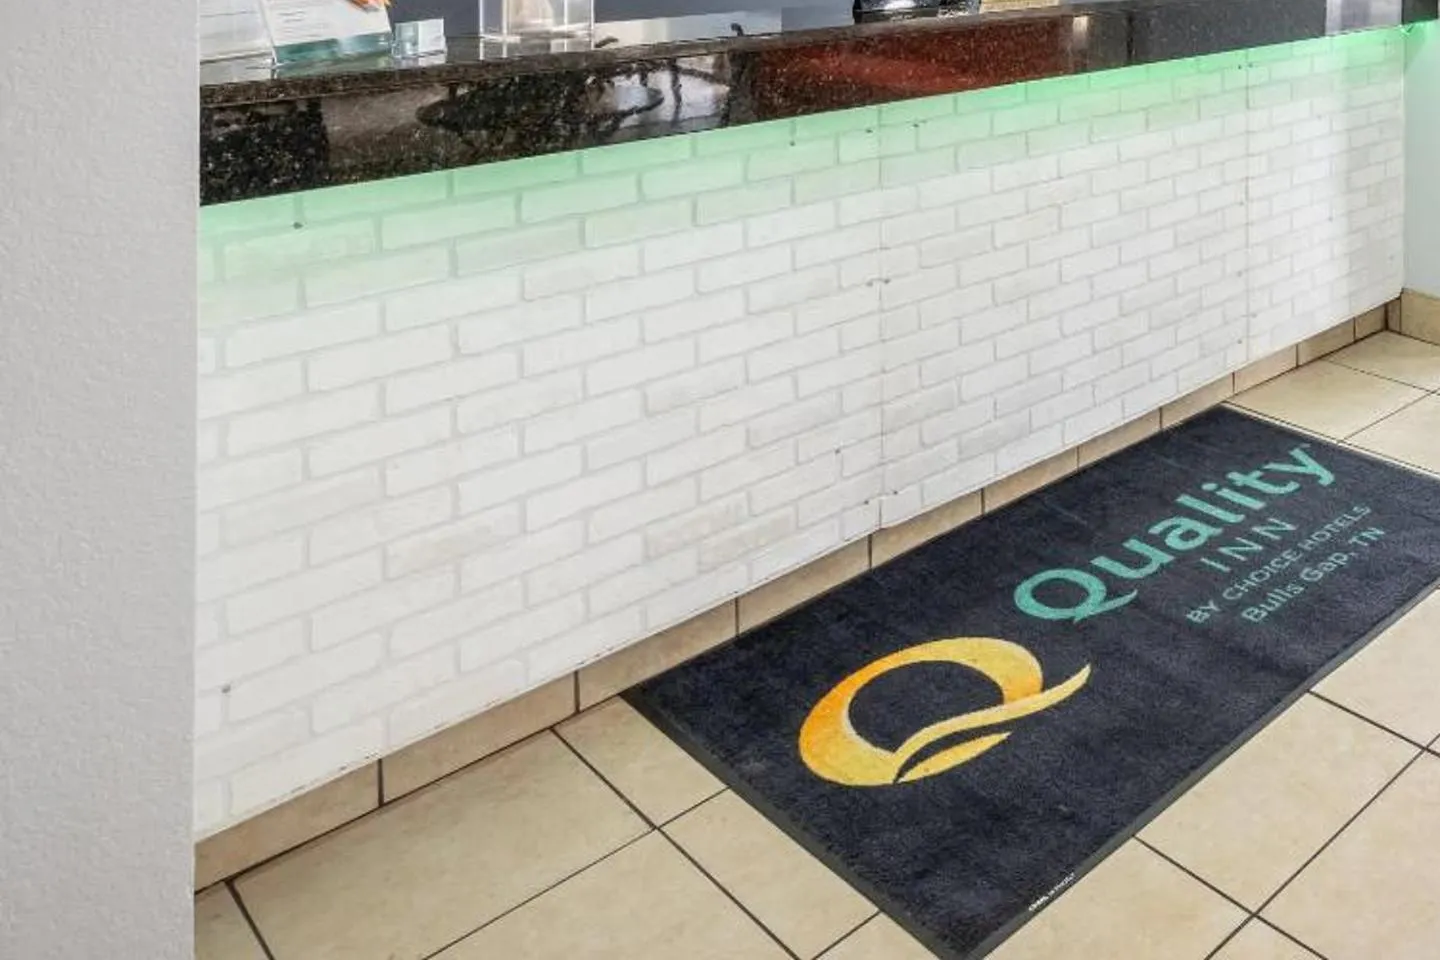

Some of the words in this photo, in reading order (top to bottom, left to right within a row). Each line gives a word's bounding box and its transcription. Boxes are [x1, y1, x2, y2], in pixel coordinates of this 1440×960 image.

[1014, 446, 1335, 623] Quality
[1186, 600, 1221, 623] BY
[1222, 548, 1303, 600] CHOICE
[1298, 505, 1372, 551] HOTELS
[1200, 517, 1297, 572] INN
[1241, 583, 1304, 622] Bulls
[1300, 551, 1359, 582] Gap,
[1348, 527, 1385, 547] TN
